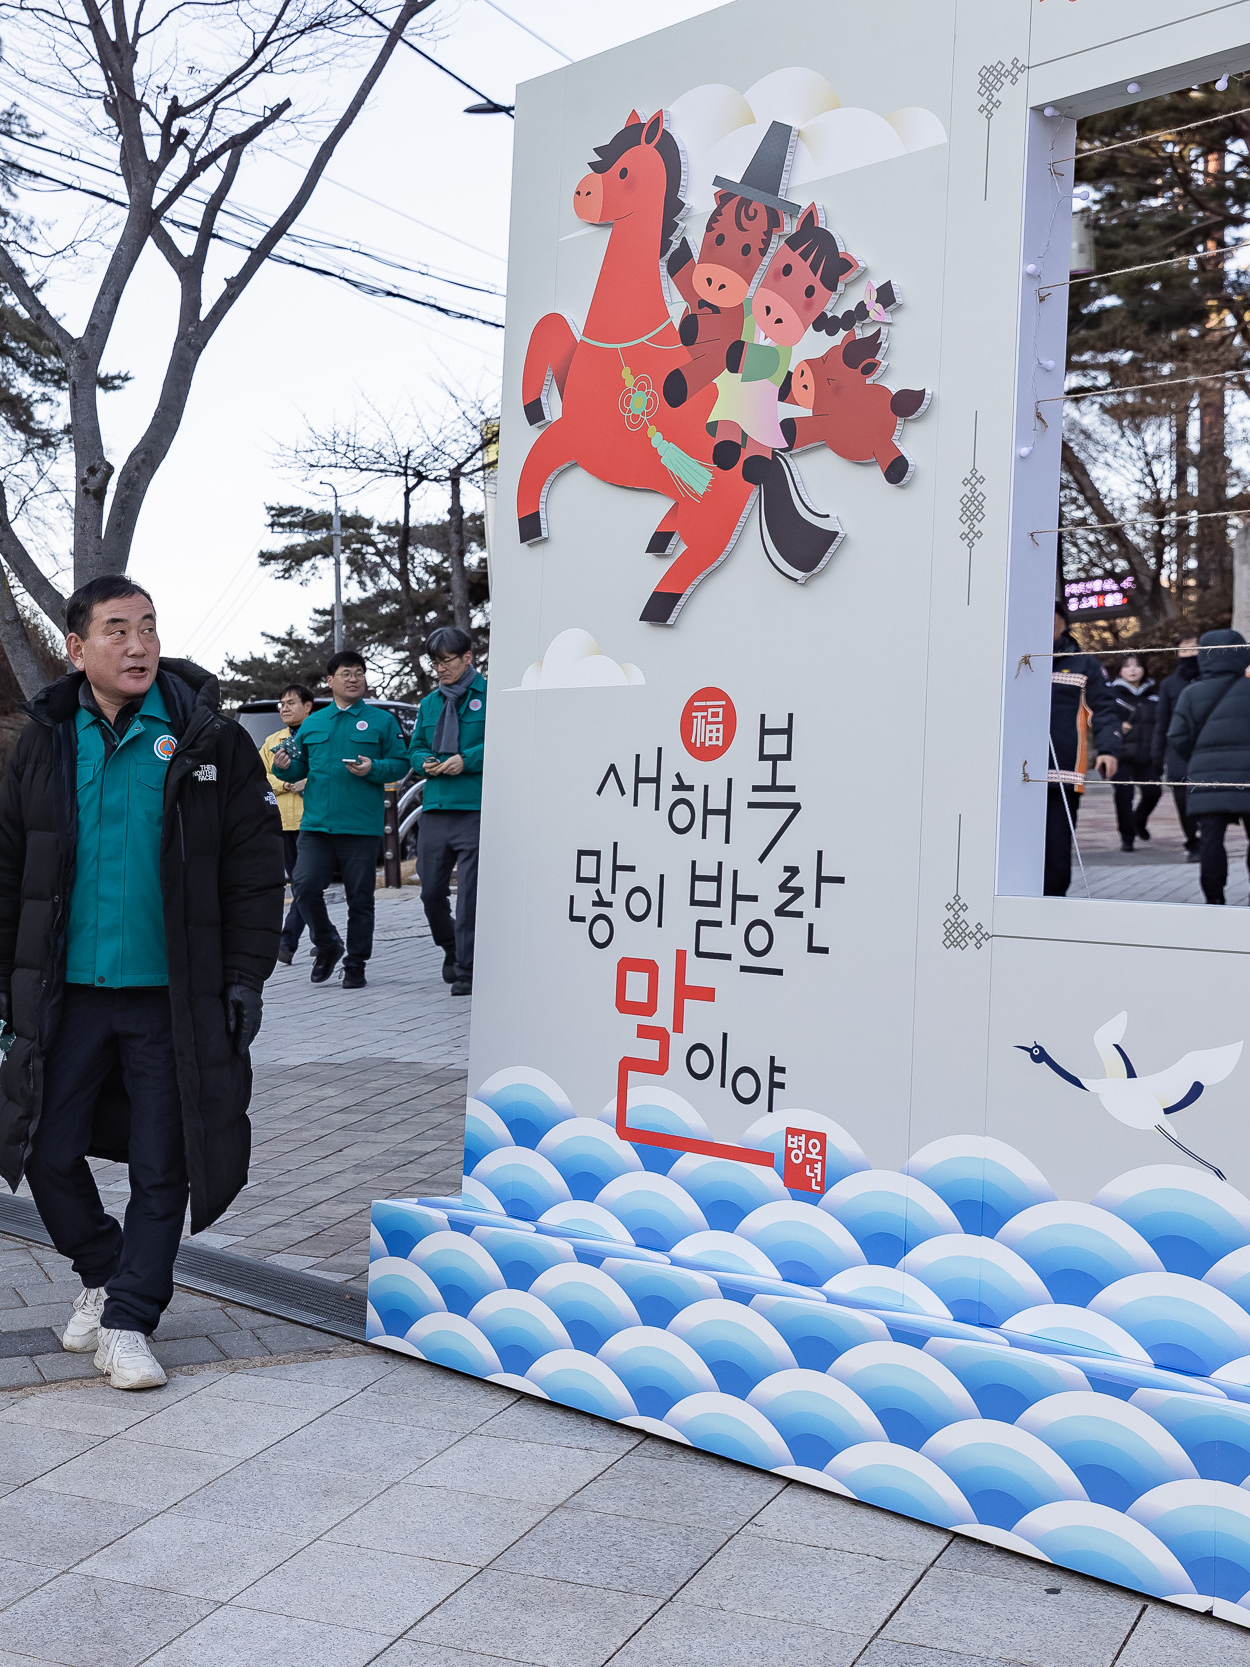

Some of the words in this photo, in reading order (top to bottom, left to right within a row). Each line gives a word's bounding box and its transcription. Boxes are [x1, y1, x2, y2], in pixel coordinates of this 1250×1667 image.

[691, 701, 726, 748] 福
[192, 769, 213, 777] NORTH
[596, 747, 733, 844] 새해
[747, 713, 802, 864] 복
[569, 842, 664, 949] 많이
[690, 850, 845, 976] 받으란
[615, 949, 786, 1168] 말이야
[787, 1134, 823, 1191] 병오년
